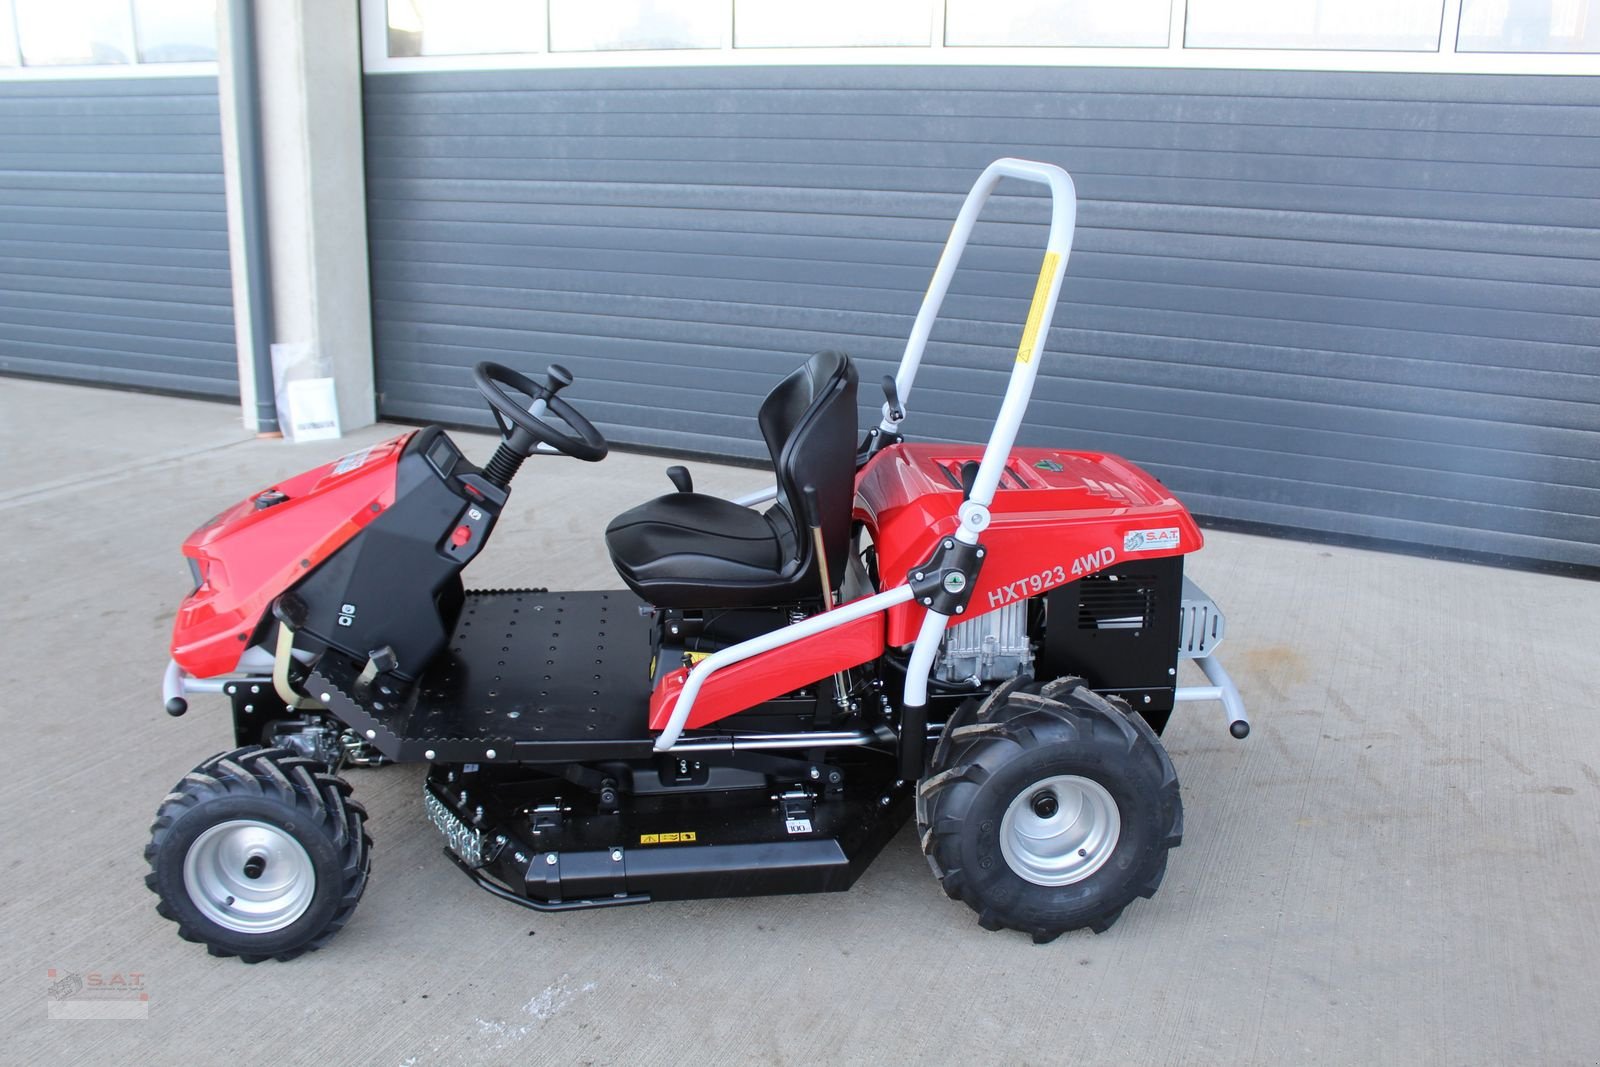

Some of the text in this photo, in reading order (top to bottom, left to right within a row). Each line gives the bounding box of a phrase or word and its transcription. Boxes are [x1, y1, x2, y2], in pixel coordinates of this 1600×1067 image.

[1146, 530, 1178, 540] S.A.T.
[988, 546, 1116, 608] HXT923 4WD
